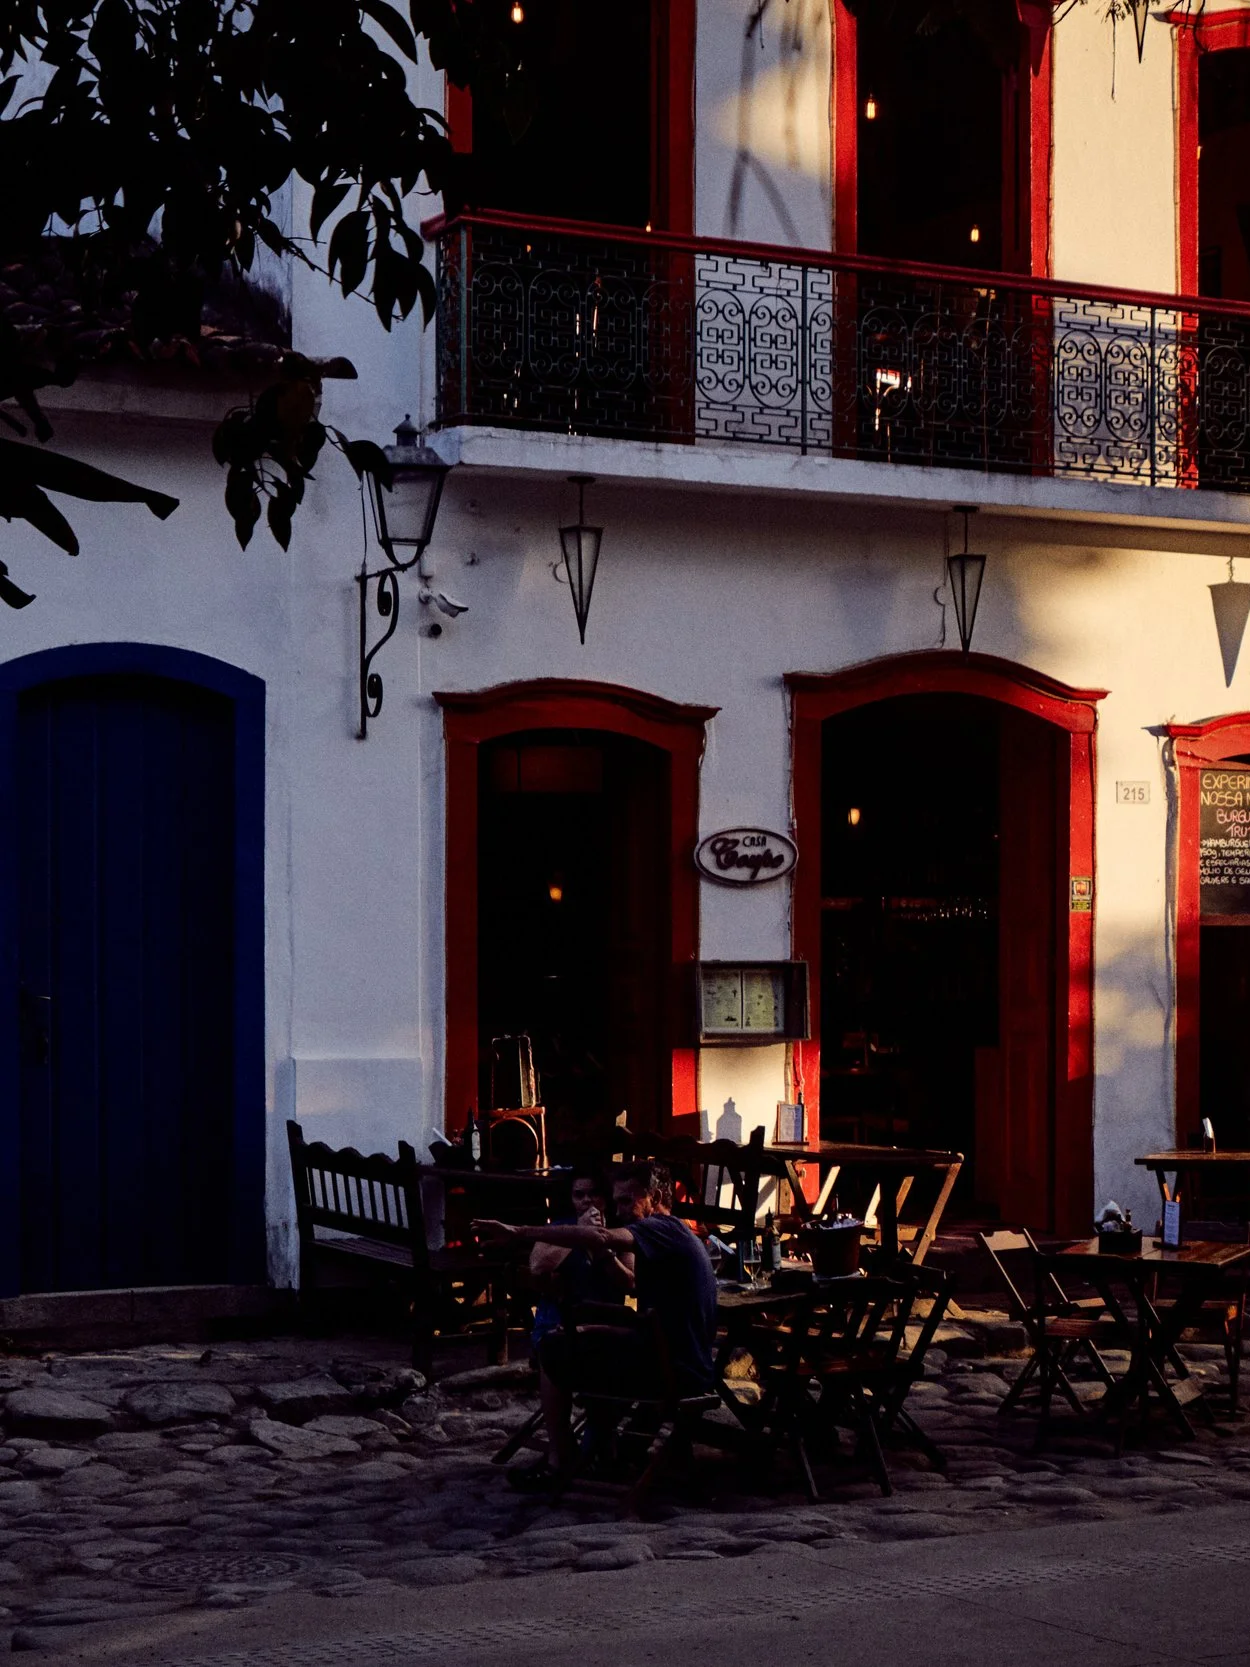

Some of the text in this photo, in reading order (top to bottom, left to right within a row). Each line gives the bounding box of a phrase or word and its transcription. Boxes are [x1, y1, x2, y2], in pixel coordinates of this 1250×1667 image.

[1123, 787, 1145, 801] 215
[1200, 791, 1243, 807] NOSSA
[742, 836, 767, 847] CASA
